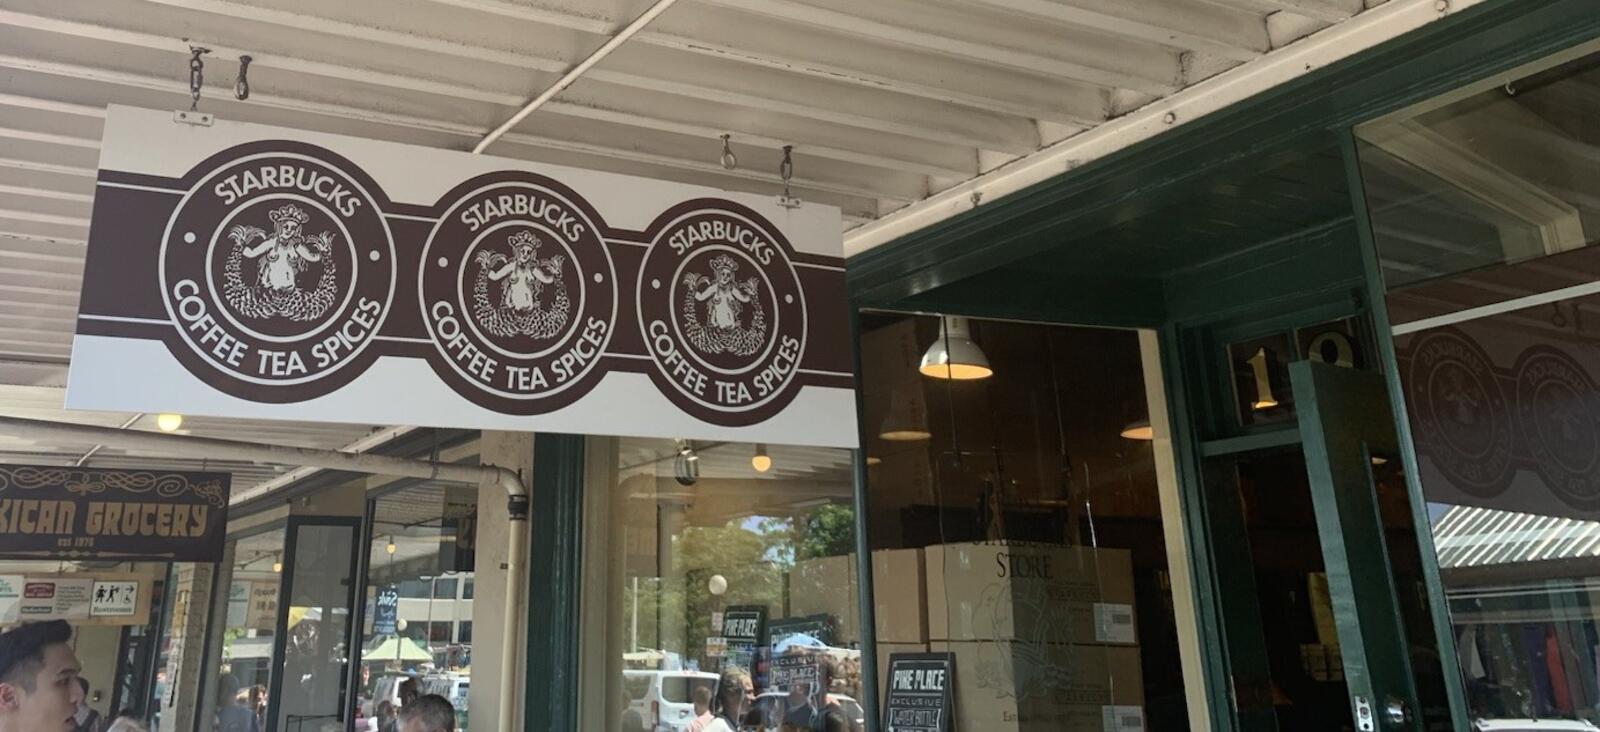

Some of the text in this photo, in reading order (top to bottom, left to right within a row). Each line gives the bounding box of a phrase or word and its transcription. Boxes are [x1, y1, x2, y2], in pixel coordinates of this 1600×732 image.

[215, 165, 361, 218] STARBUCKS
[461, 194, 585, 243] STARBUCKS
[668, 220, 775, 266] STARBUCKS
[173, 279, 381, 376] COFFEE TEA SPICES
[431, 300, 607, 391] COFFEE TEA SPICES
[649, 318, 800, 404] COFFEE TEA SPICES
[85, 502, 208, 538] GROCERY
[997, 552, 1053, 579] STORE
[893, 669, 945, 691] PIKE PLACE
